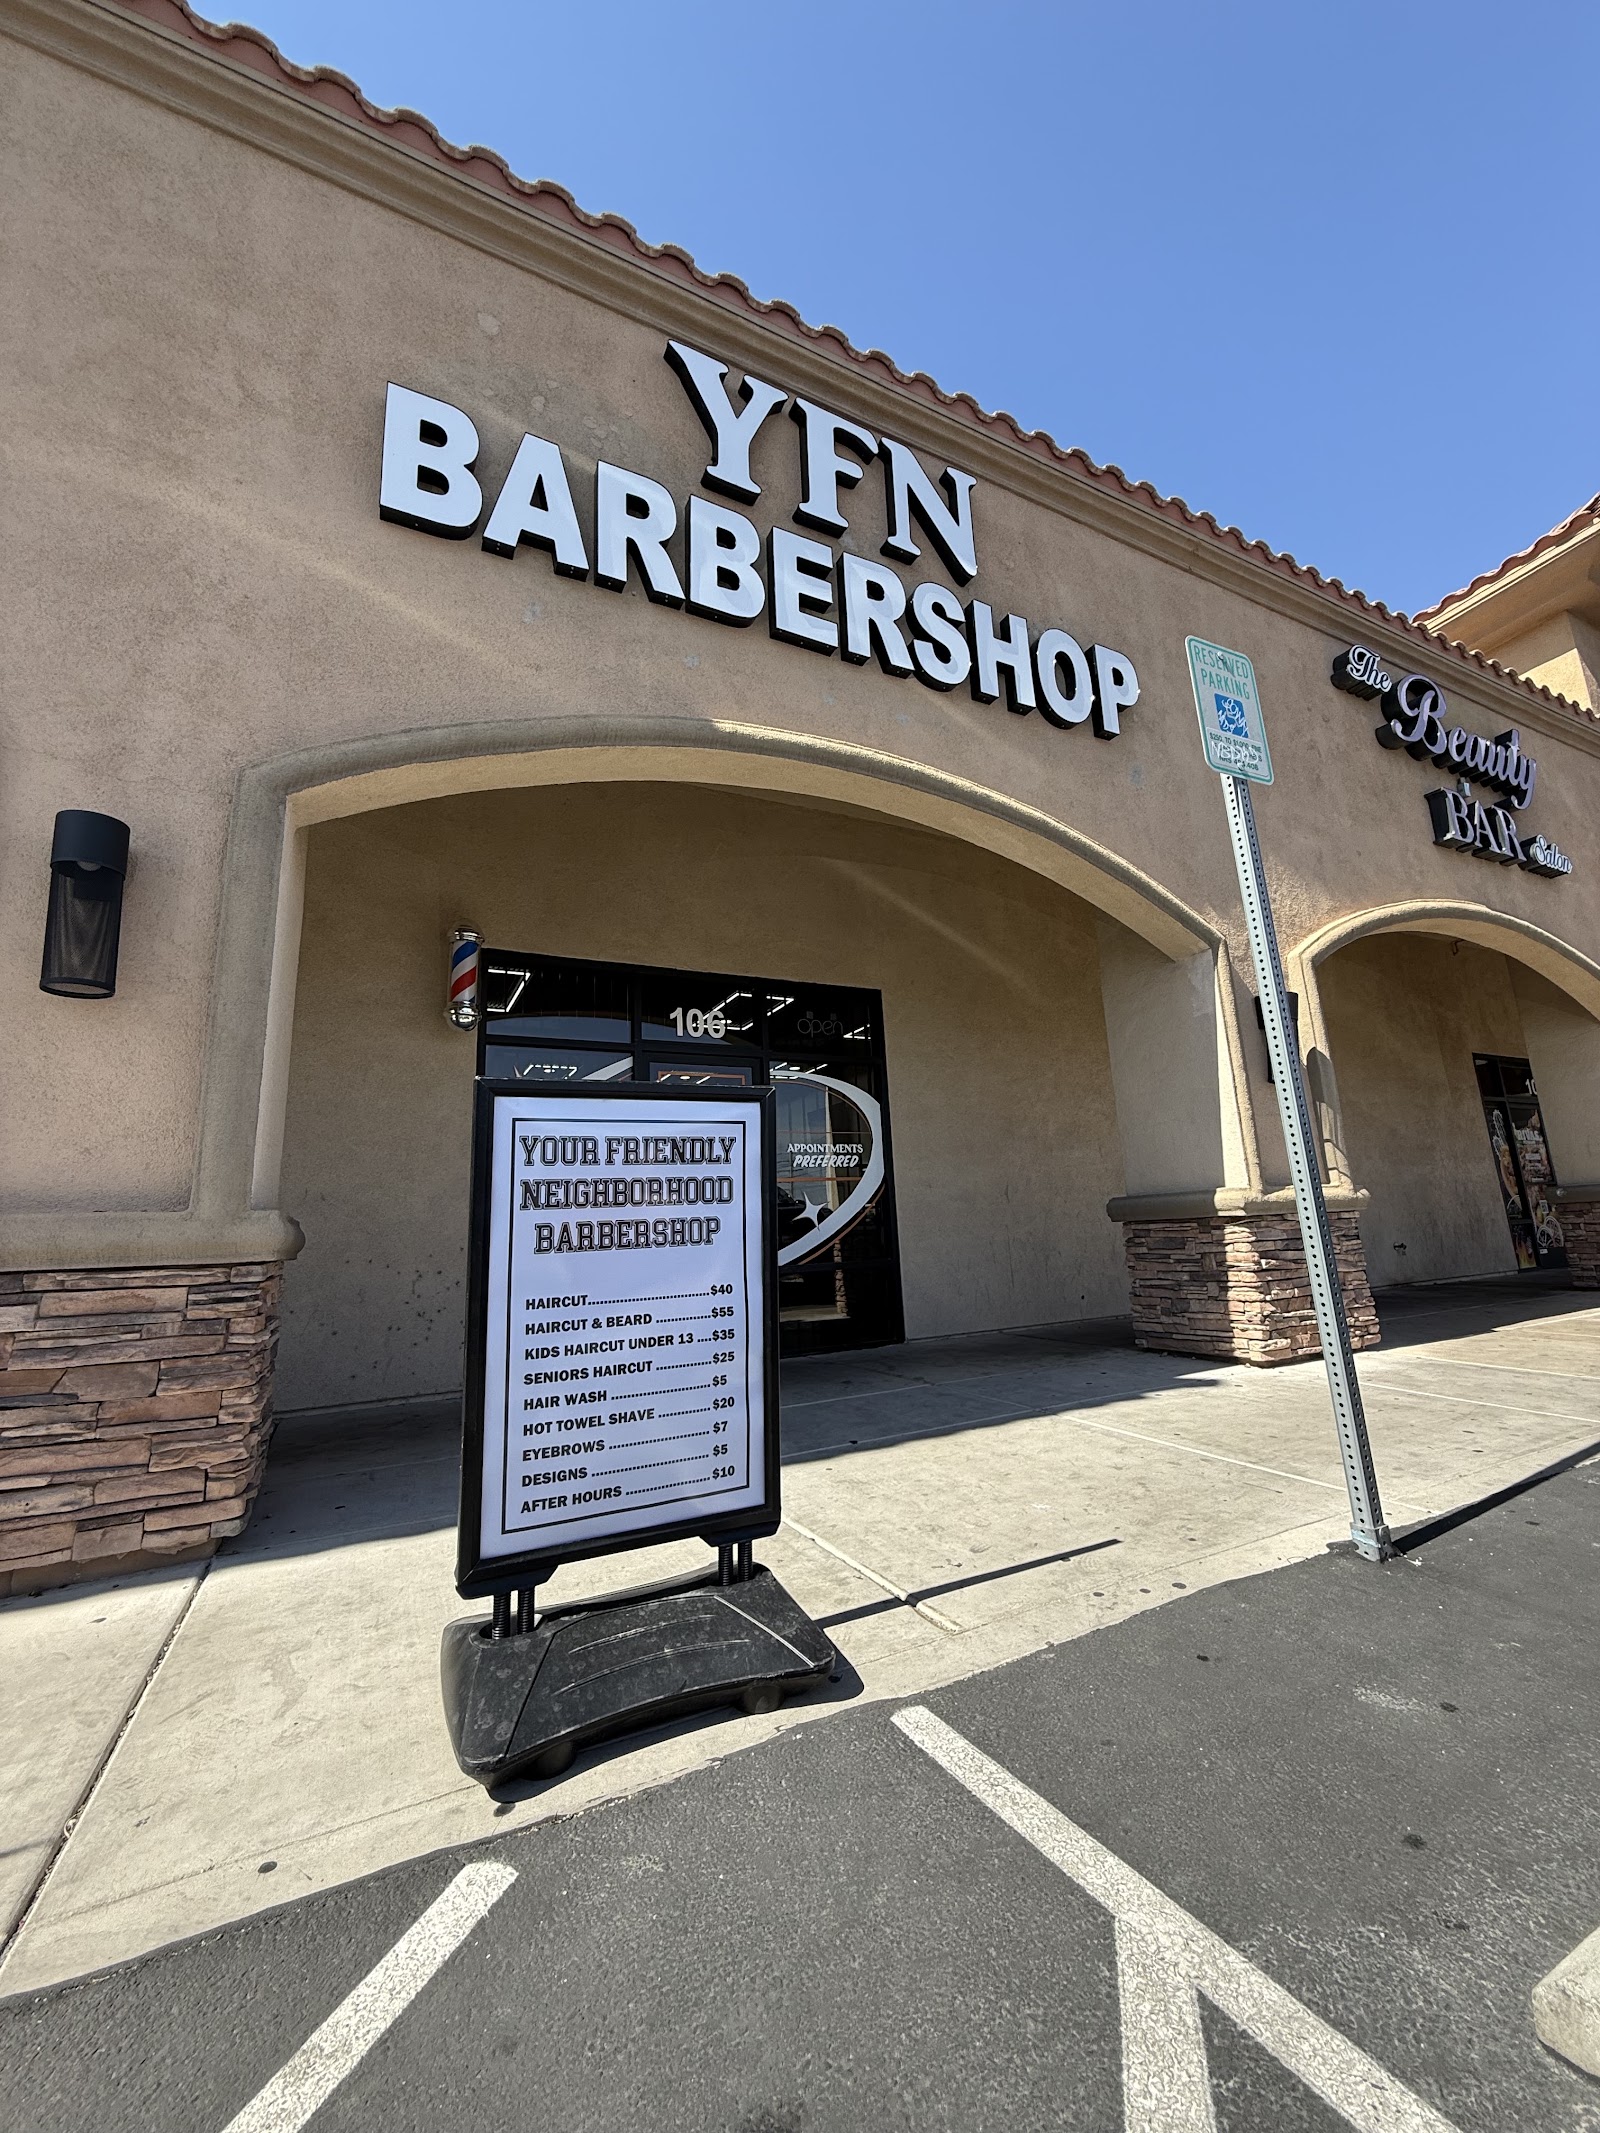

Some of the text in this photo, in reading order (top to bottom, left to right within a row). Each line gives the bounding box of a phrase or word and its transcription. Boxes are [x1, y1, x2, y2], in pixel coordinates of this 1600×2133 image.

[665, 340, 978, 585] YFN
[379, 382, 1140, 740] BARBERSHOP
[1194, 645, 1249, 679] RESERVED
[1346, 644, 1392, 692] The
[1201, 668, 1250, 700] PARKING
[1389, 674, 1537, 810] Beauty
[1437, 786, 1573, 874] BAR Salon
[669, 1006, 726, 1039] 106
[797, 1017, 844, 1038] open
[519, 1135, 737, 1166] YOUR FRIENDLY
[787, 1143, 864, 1154] APPOINTMENTS
[793, 1154, 860, 1168] PREFERRED
[519, 1175, 734, 1211] NEIGHBORHOOD
[533, 1215, 721, 1255] BARBERSHOP
[525, 1283, 734, 1311] HAIRCUT $40
[525, 1306, 735, 1336] HAIRCUT & BEARD $55
[524, 1328, 736, 1361] KIDS HAIRCUT UNDER 13 $35
[523, 1351, 736, 1386] SENIORS HAIRCUT $25
[523, 1374, 728, 1411] HAIR WASH $5
[523, 1396, 736, 1437] HOT TOWEL SHAVE $20
[522, 1420, 729, 1462] EYEBROWS $7
[521, 1443, 729, 1488] DESIGNS $5
[520, 1465, 736, 1514] AFTER HOURS $10
